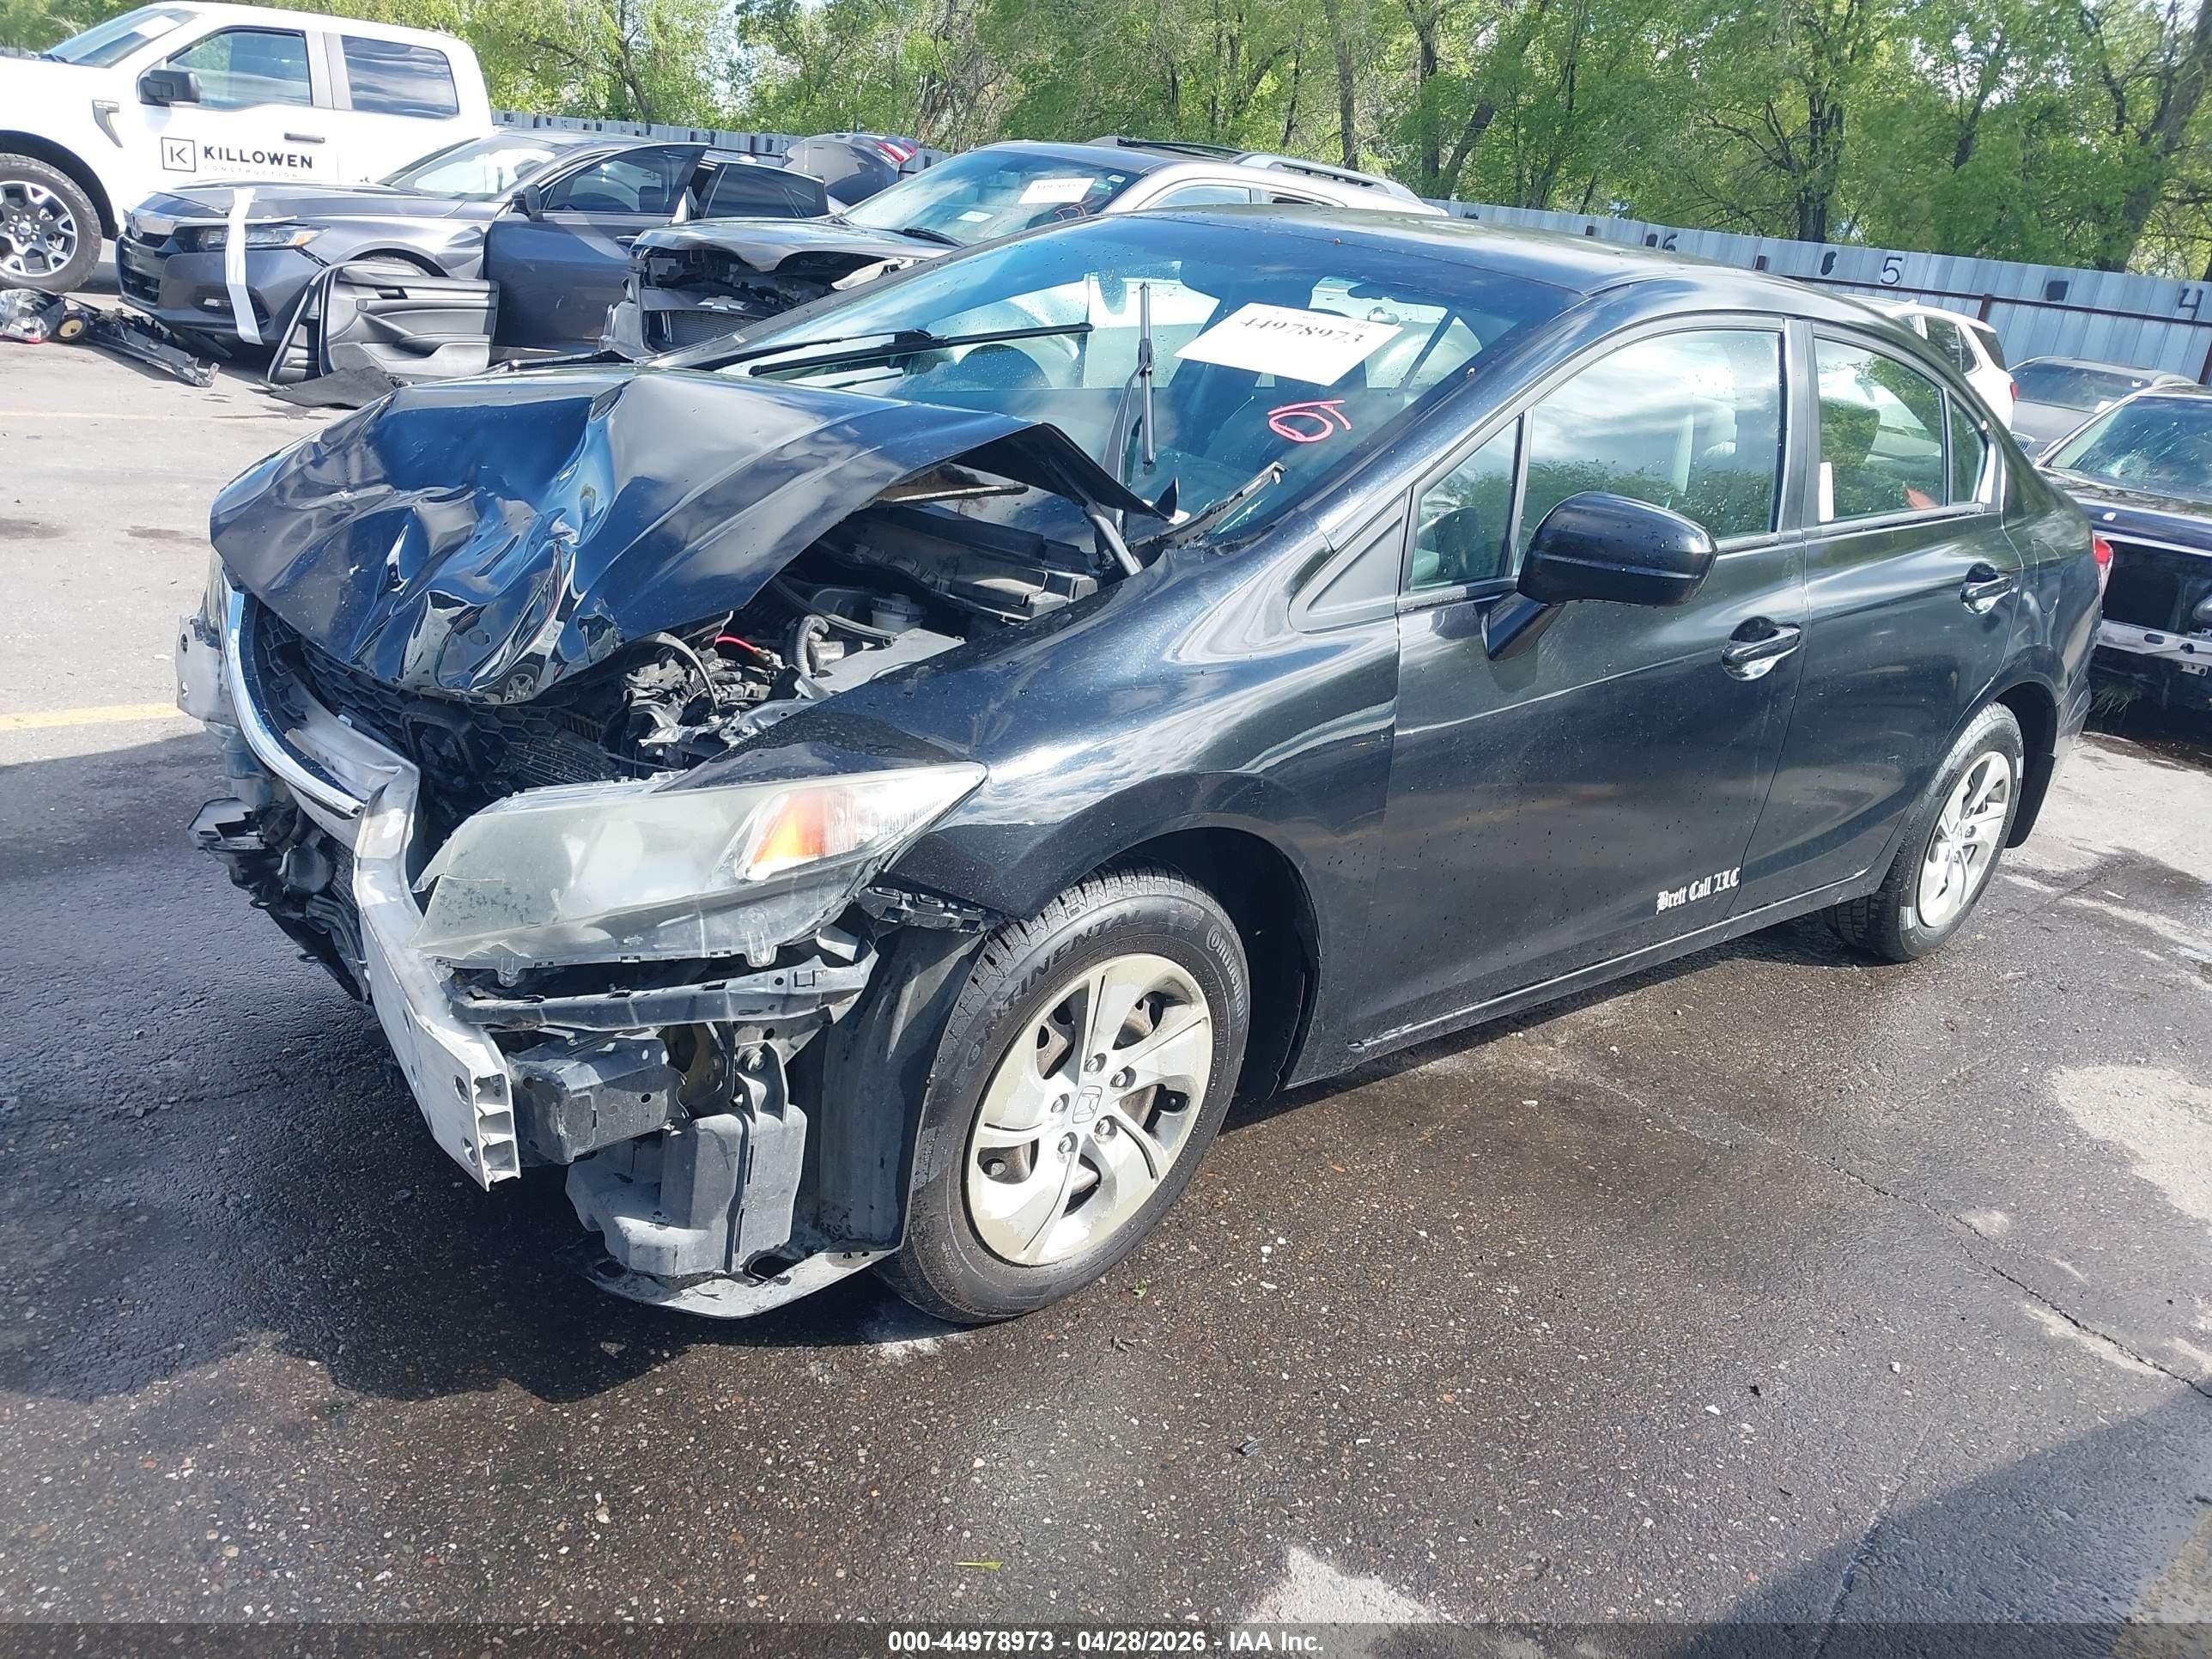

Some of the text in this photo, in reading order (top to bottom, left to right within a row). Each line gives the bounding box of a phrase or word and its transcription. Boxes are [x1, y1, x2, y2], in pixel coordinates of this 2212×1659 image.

[204, 145, 313, 169] KILLOWEN
[1881, 257, 1903, 284] 5
[2179, 289, 2203, 320] 4
[1239, 317, 1364, 343] 44978973
[1656, 885, 1687, 915] Brett
[1688, 875, 1712, 902] Call
